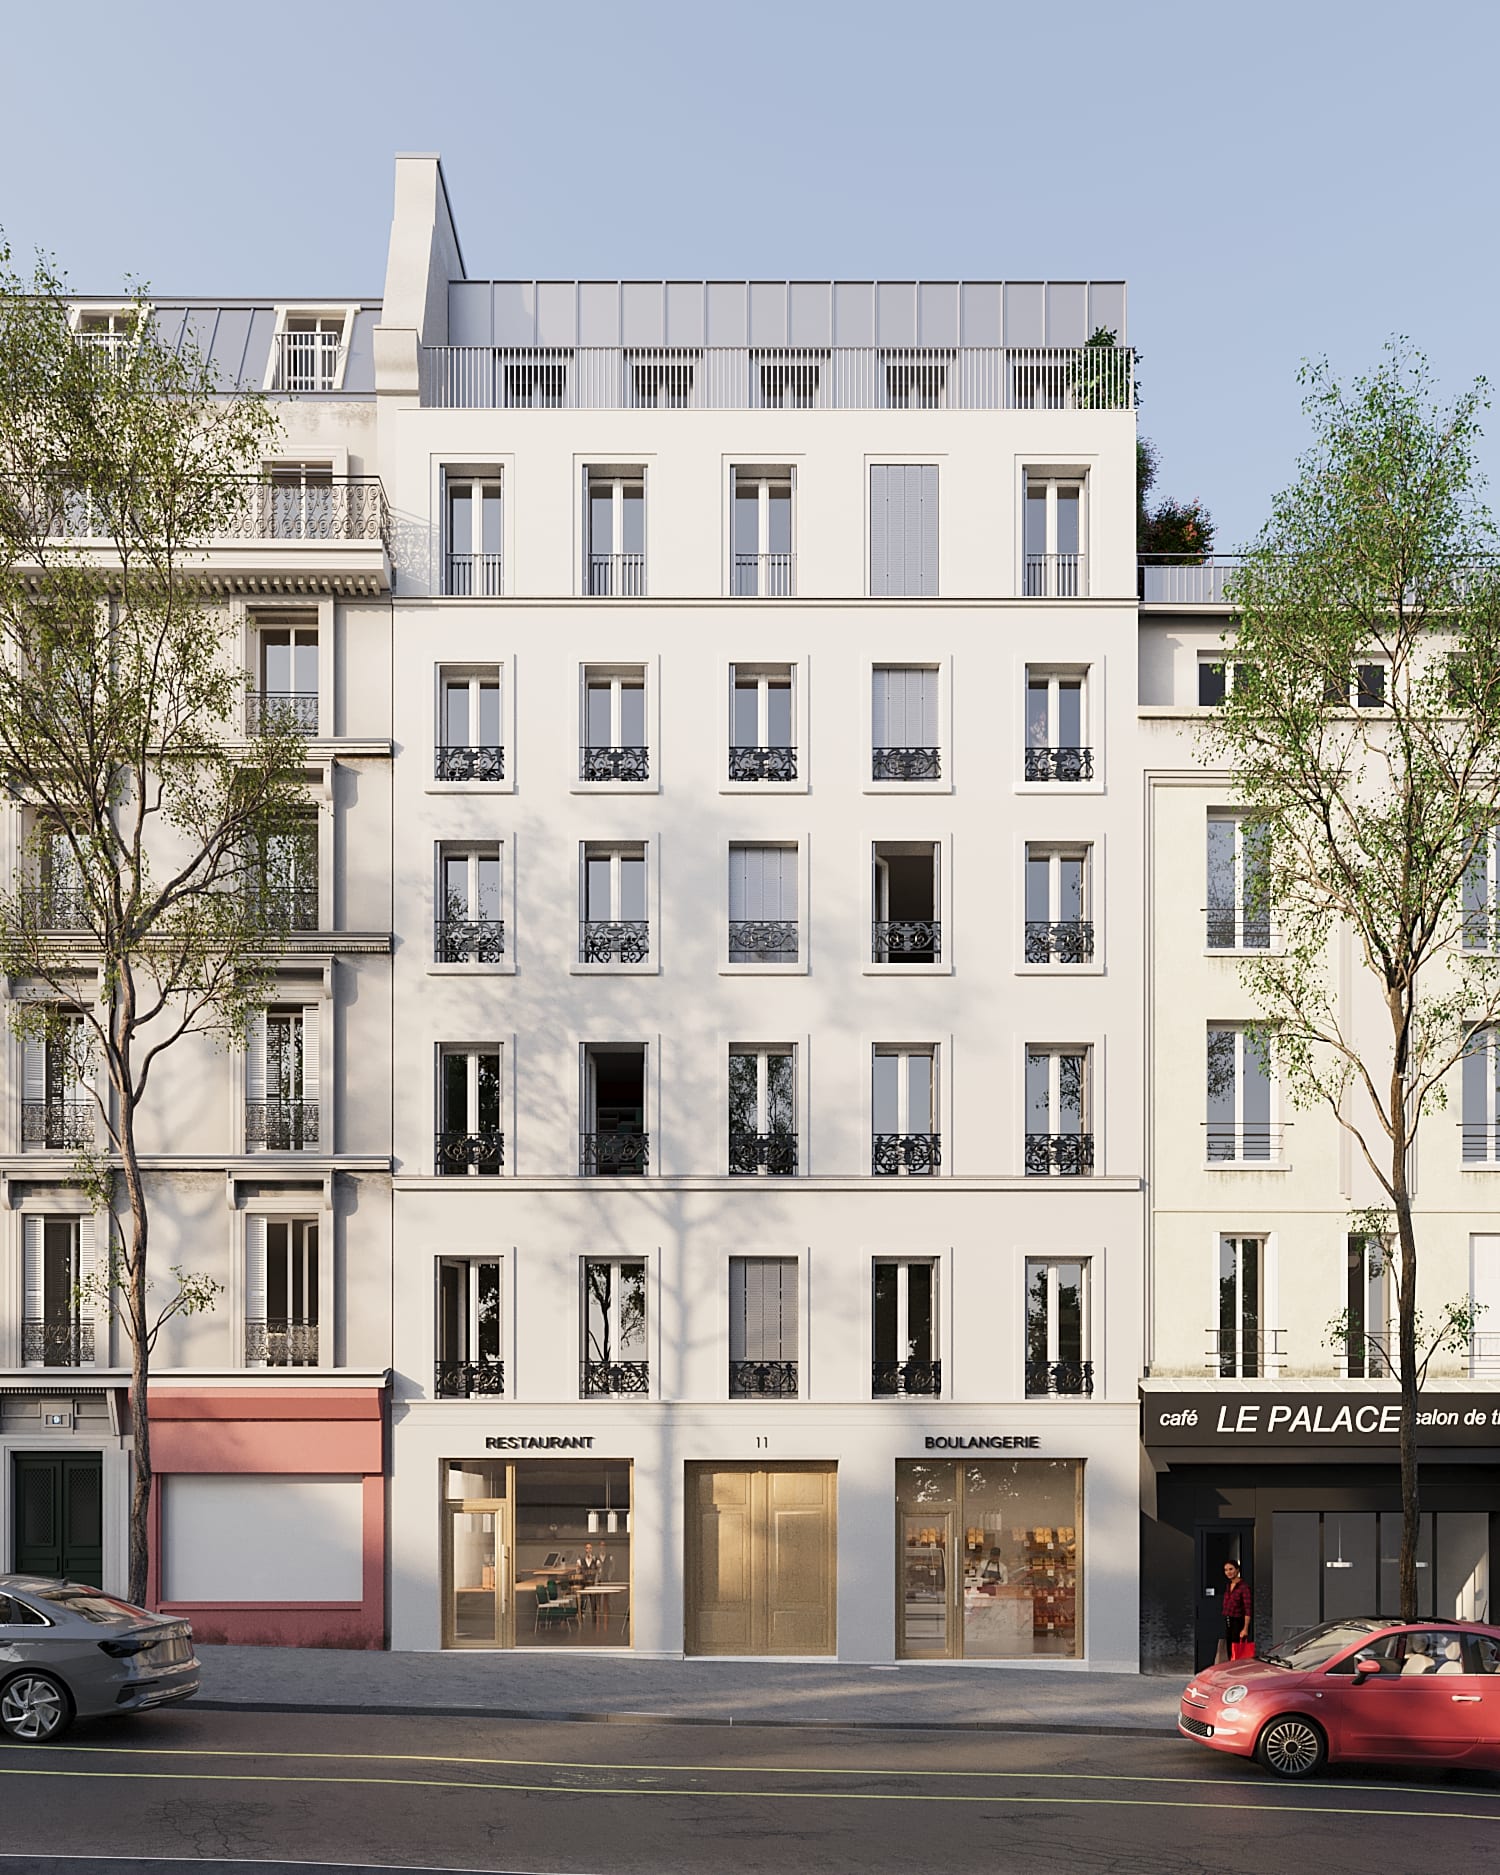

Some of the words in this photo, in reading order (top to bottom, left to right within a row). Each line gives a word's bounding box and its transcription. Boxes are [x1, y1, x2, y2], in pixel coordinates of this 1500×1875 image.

[1160, 1410, 1198, 1426] café
[1216, 1405, 1260, 1432] LE
[1267, 1405, 1403, 1433] PALACE
[1463, 1408, 1487, 1425] de
[1491, 1409, 1500, 1425] t
[485, 1436, 595, 1449] RESTAURANT
[756, 1436, 768, 1449] 11
[924, 1436, 1041, 1449] BOULANGERIE
